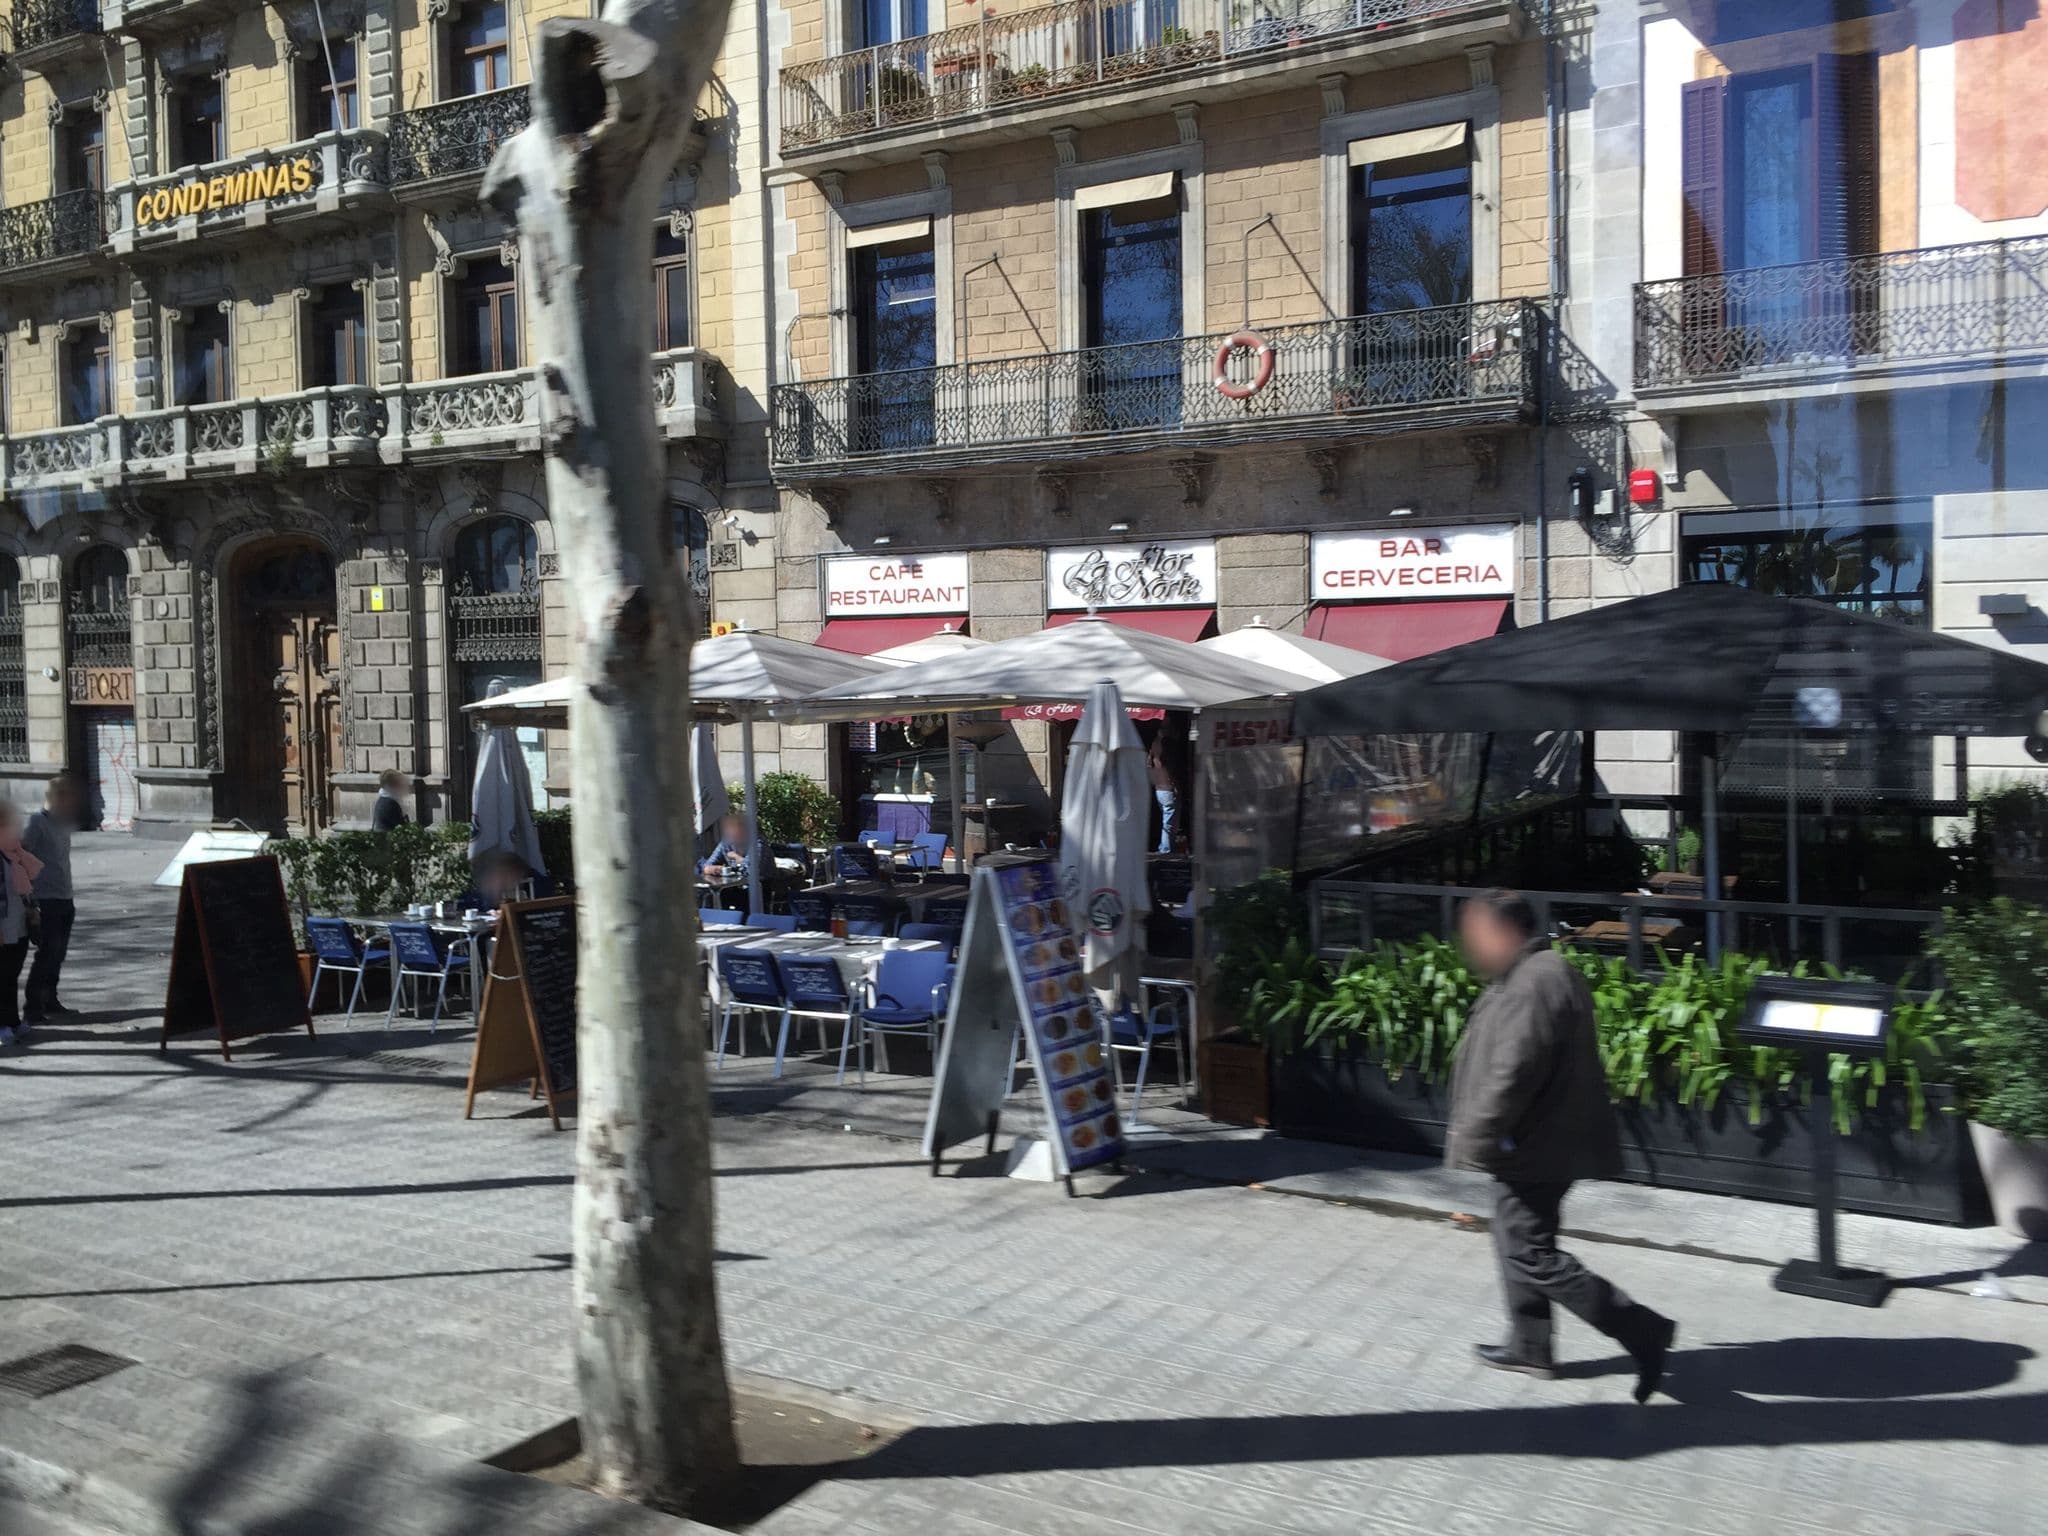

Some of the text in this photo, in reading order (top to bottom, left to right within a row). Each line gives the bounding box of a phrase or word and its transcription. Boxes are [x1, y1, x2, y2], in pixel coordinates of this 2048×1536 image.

[137, 159, 312, 225] CONDEMINAS
[1380, 538, 1442, 558] BAR
[869, 563, 924, 581] CAFE
[1063, 544, 1193, 589] La Flor
[1323, 564, 1502, 588] CERVECERIA
[830, 586, 965, 606] RESTAURANT
[1109, 572, 1200, 600] Norte
